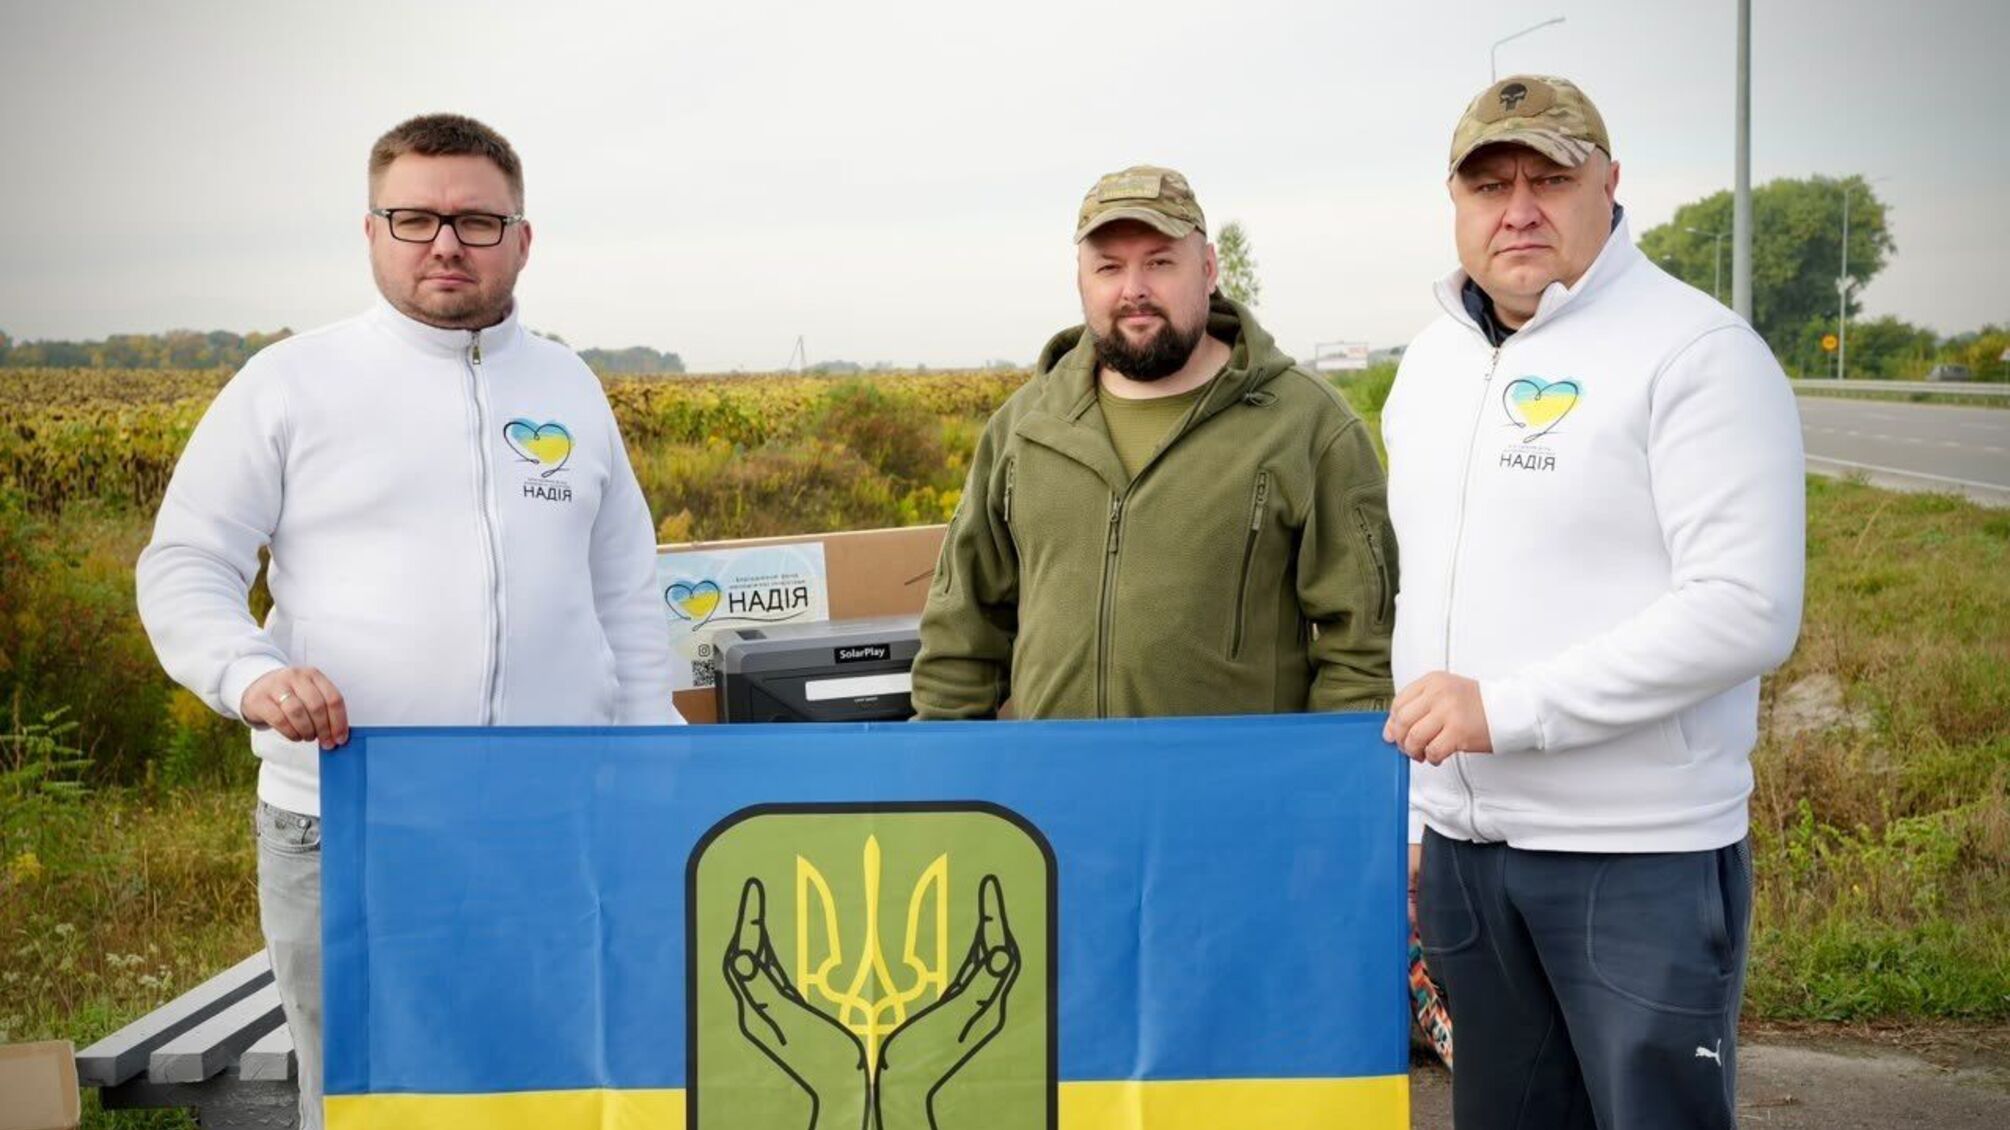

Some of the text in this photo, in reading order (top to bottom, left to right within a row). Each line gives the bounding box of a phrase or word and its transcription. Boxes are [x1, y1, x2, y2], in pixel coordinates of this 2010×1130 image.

[1499, 453, 1556, 471] НАДІЯ
[523, 485, 572, 502] НАДІЯ
[728, 586, 808, 613] НАДІЯ
[839, 647, 885, 659] SolarPlay
